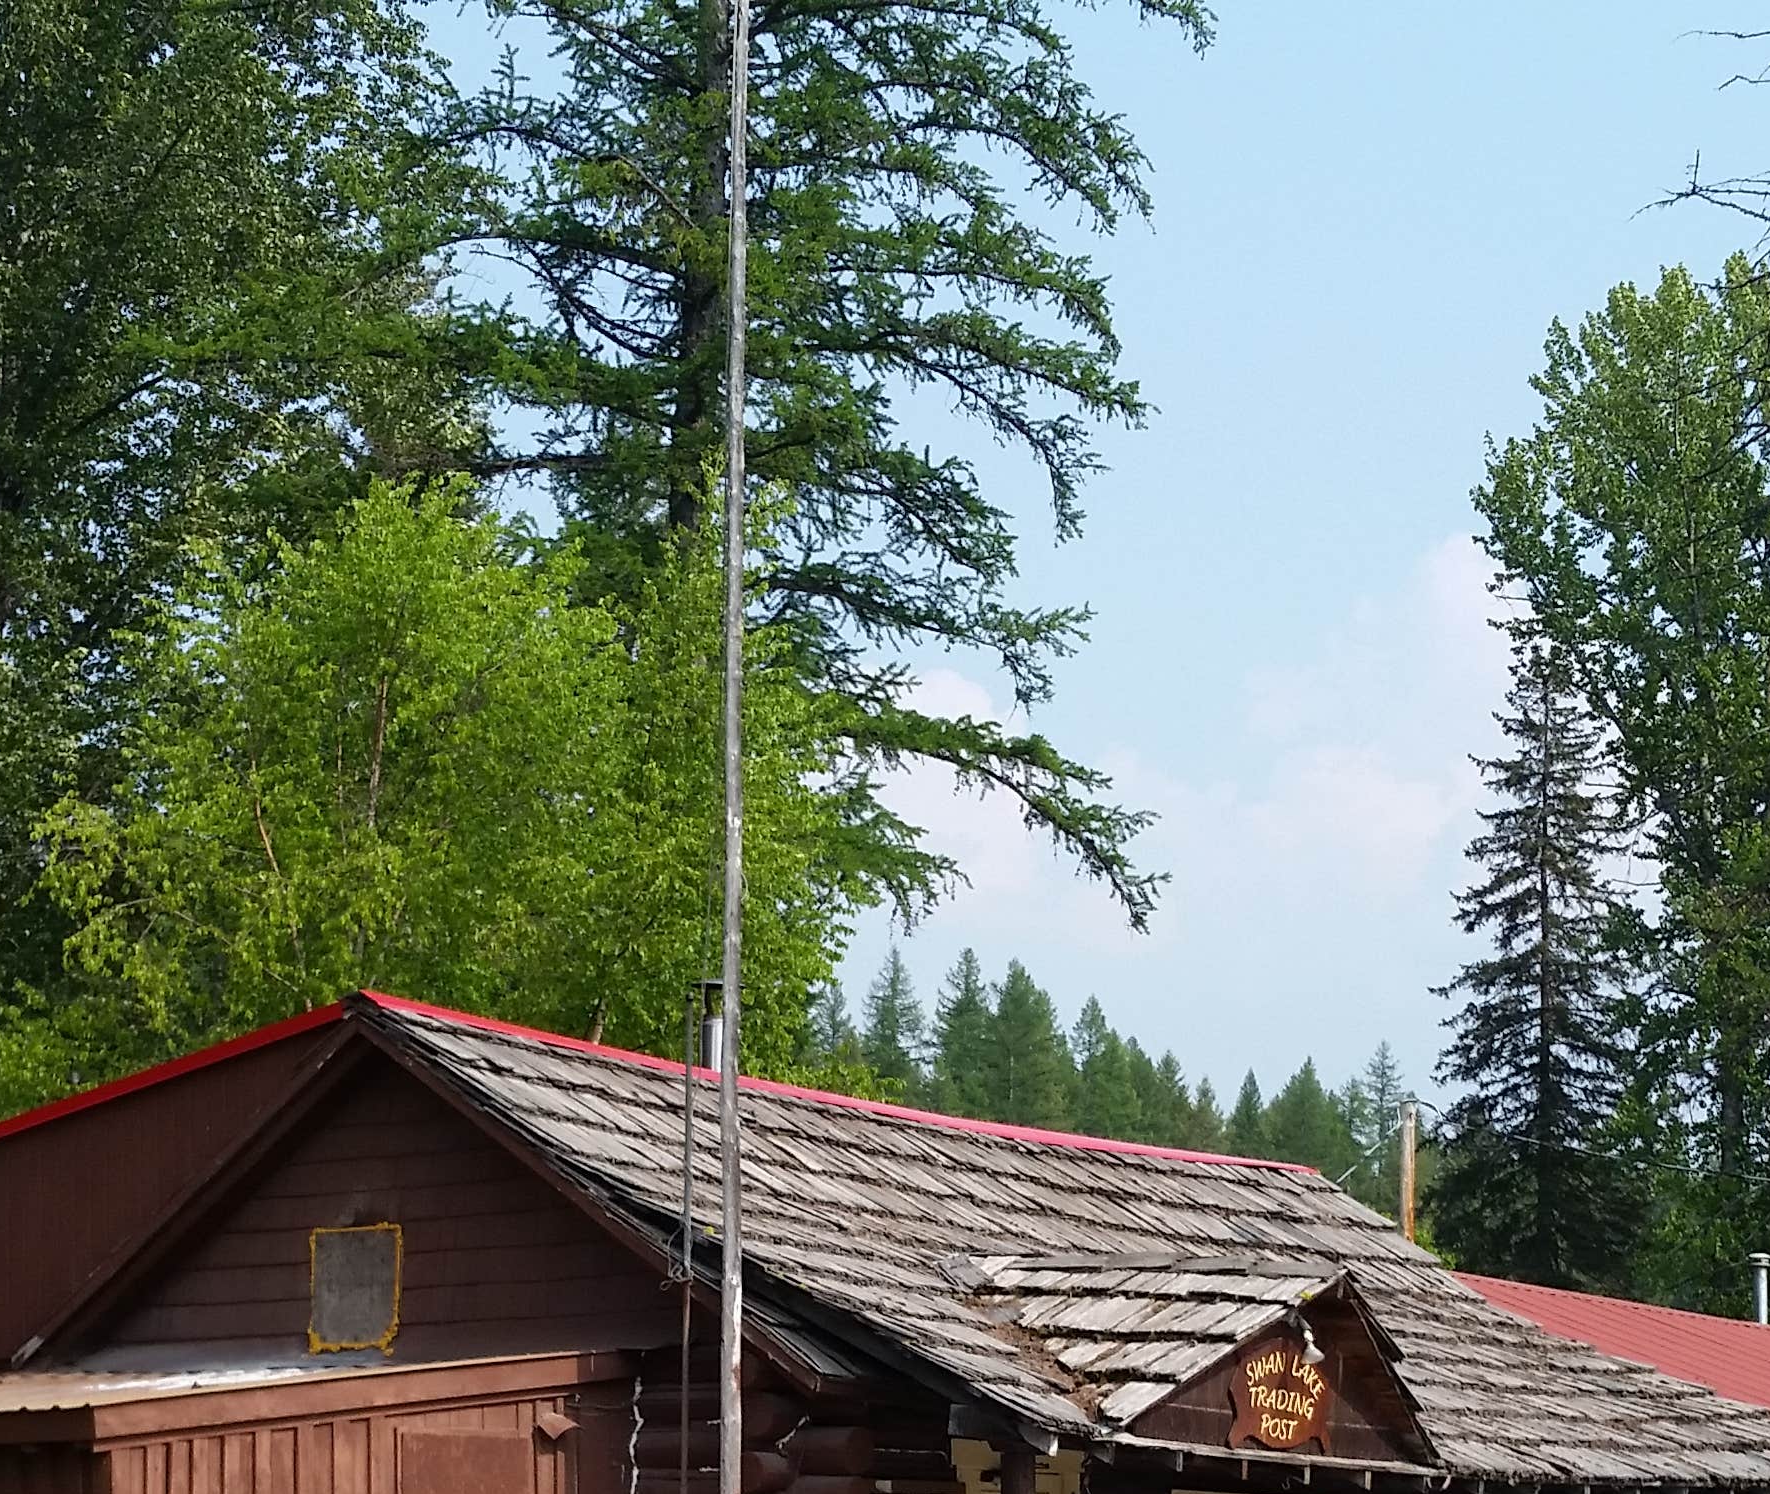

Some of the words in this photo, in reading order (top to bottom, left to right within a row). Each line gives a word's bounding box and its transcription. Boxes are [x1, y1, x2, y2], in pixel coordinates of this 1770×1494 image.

[1246, 1351, 1286, 1387] SWAN
[1291, 1354, 1326, 1401] LAKE
[1249, 1385, 1316, 1421] TRADING
[1260, 1413, 1299, 1440] POST
